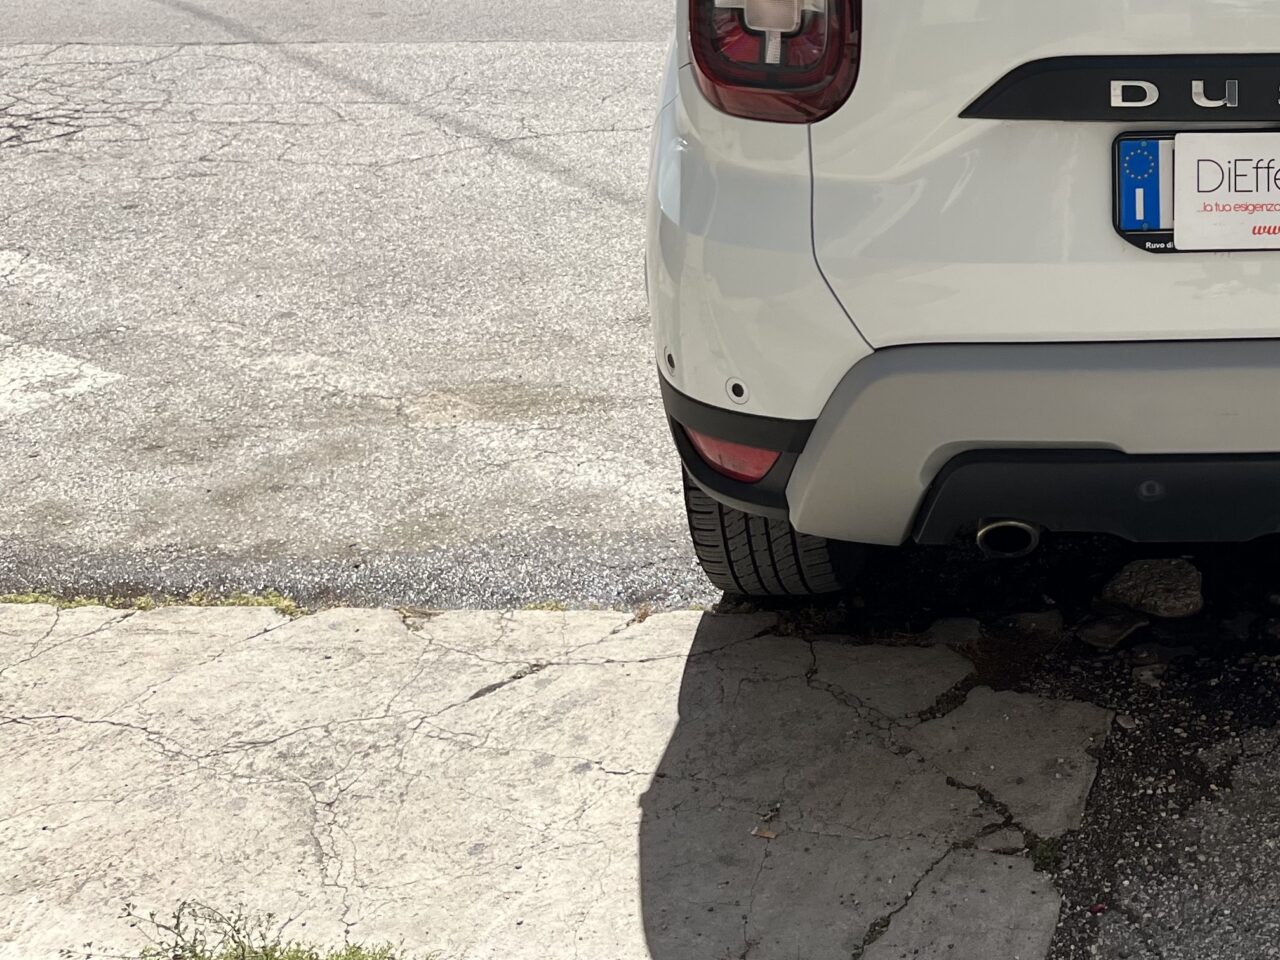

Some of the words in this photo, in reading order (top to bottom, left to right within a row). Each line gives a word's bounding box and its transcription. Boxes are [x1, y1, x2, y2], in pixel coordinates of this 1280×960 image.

[1134, 188, 1144, 220] I
[1215, 203, 1232, 212] tua
[1145, 241, 1165, 249] Ruvo
